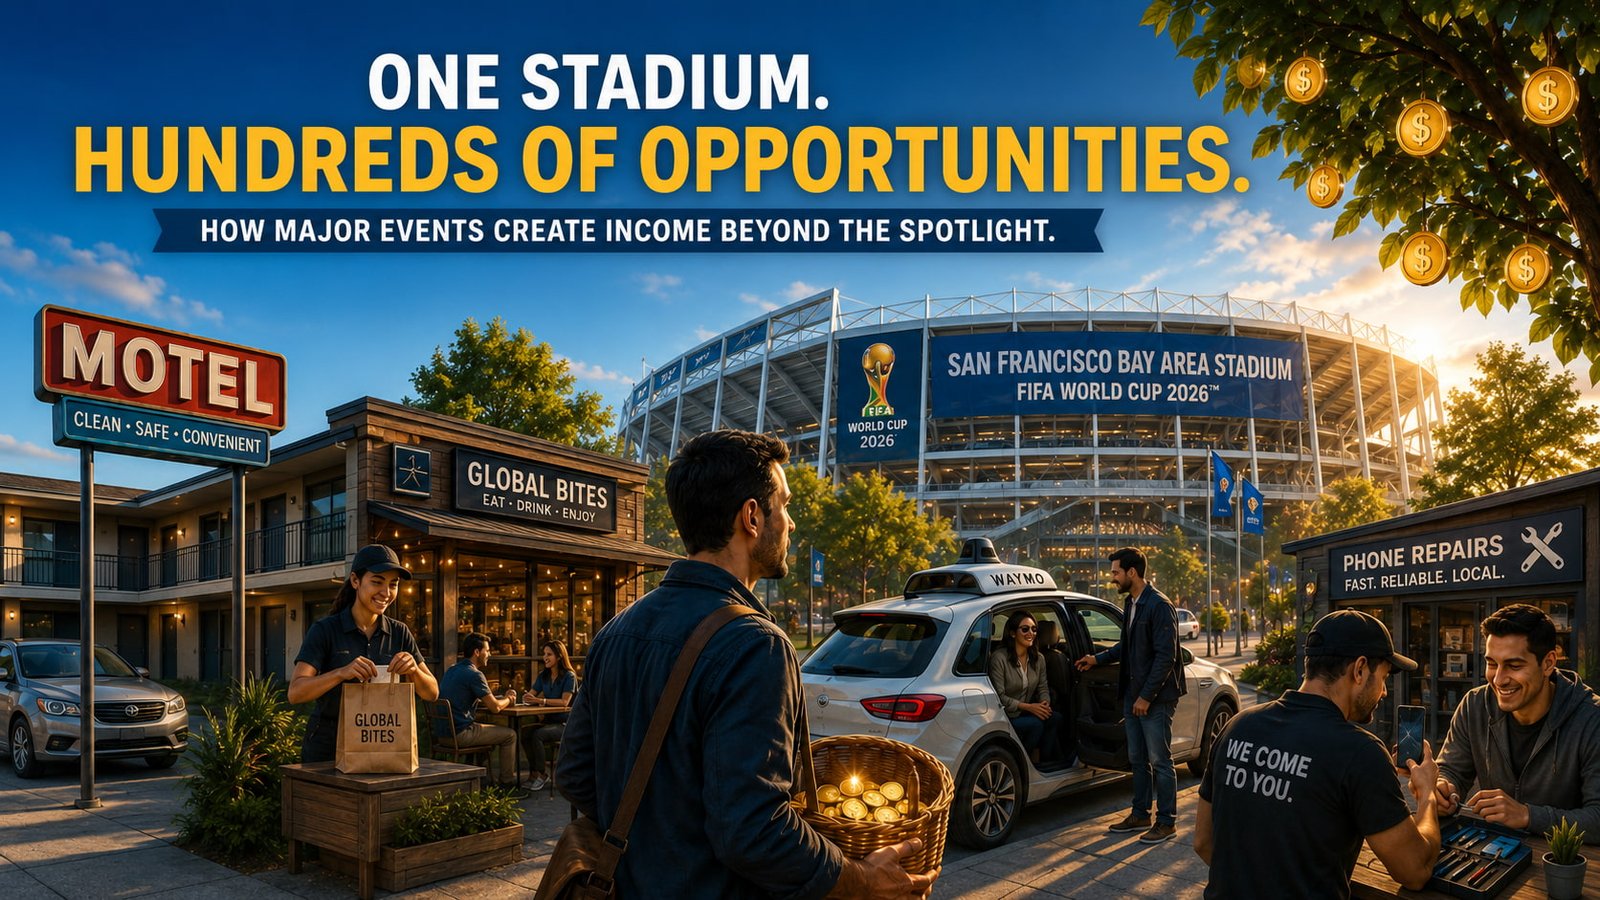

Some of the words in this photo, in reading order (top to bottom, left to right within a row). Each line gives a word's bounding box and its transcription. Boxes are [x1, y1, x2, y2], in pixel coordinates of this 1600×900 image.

[62, 322, 273, 415] MOTEL
[947, 351, 992, 377] SAN
[997, 348, 1110, 376] FRANCISCO
[1117, 348, 1155, 375] BAY
[1161, 350, 1210, 377] AREA
[1214, 352, 1293, 381] STADIUM
[1017, 382, 1055, 401] FIFA
[1059, 382, 1123, 401] WORLD
[1128, 382, 1163, 401] CUP
[74, 411, 122, 433] CLEAN
[134, 421, 170, 441] SAFE
[182, 427, 261, 454] CONVENIENT
[847, 420, 885, 433] WORLD
[886, 419, 908, 431] CUP
[467, 461, 549, 499] GLOBAL
[556, 477, 607, 509] BITES
[482, 494, 505, 508] EAT
[516, 499, 552, 517] DRINK
[562, 507, 596, 523] ENJOY
[1343, 547, 1406, 572] PHONE
[1411, 534, 1505, 565] REPAIRS
[990, 573, 1045, 587] WAYMO
[1344, 576, 1377, 592] FAST.
[1380, 570, 1447, 589] RELIABLE.
[1452, 565, 1505, 583] LOCAL.
[355, 713, 401, 727] GLOBAL
[361, 729, 395, 743] BITES
[1226, 738, 1253, 763] WE
[1255, 745, 1312, 779] COME
[1225, 764, 1247, 789] TO
[1251, 772, 1293, 803] YOU.
